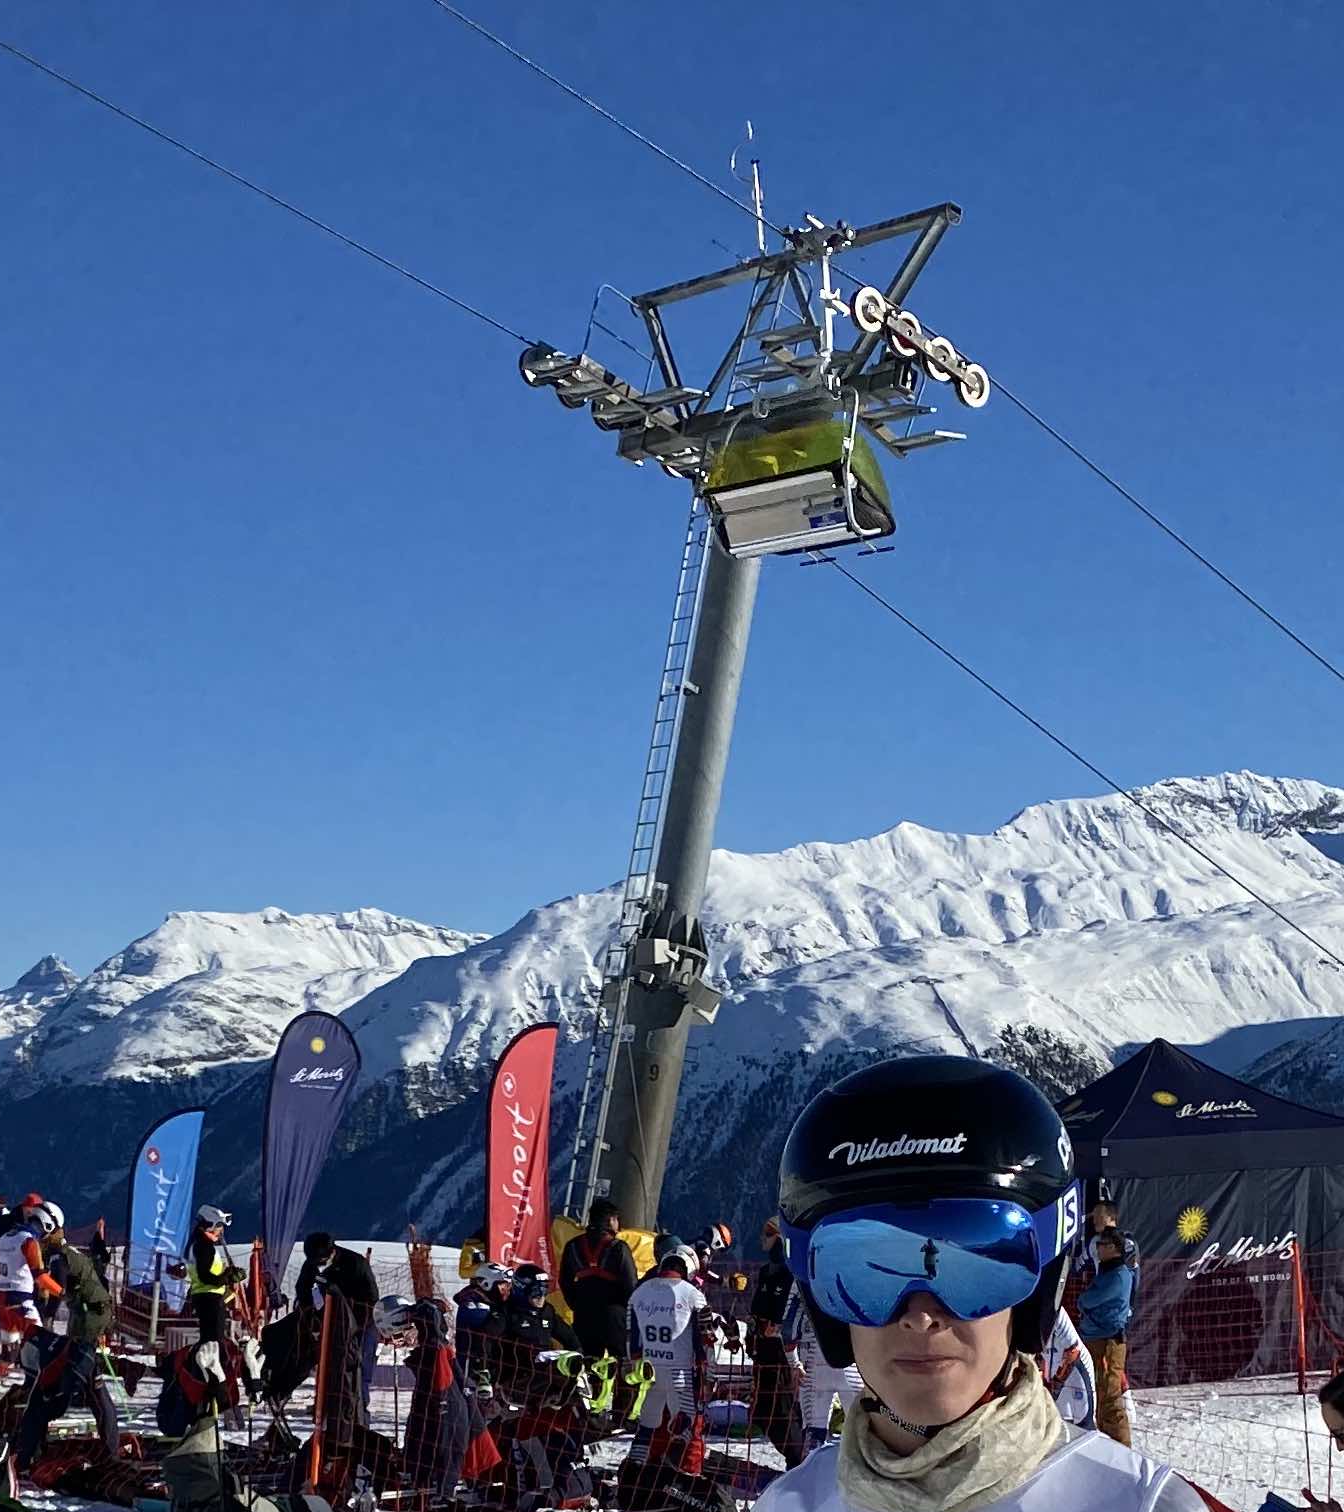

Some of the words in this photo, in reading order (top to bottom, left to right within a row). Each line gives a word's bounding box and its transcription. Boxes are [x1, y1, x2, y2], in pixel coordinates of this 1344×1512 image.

[649, 1064, 659, 1082] 9
[828, 1132, 967, 1166] Viladomat
[1212, 1231, 1298, 1269] Moritz
[645, 1325, 672, 1343] 68
[644, 1348, 674, 1360] suva
